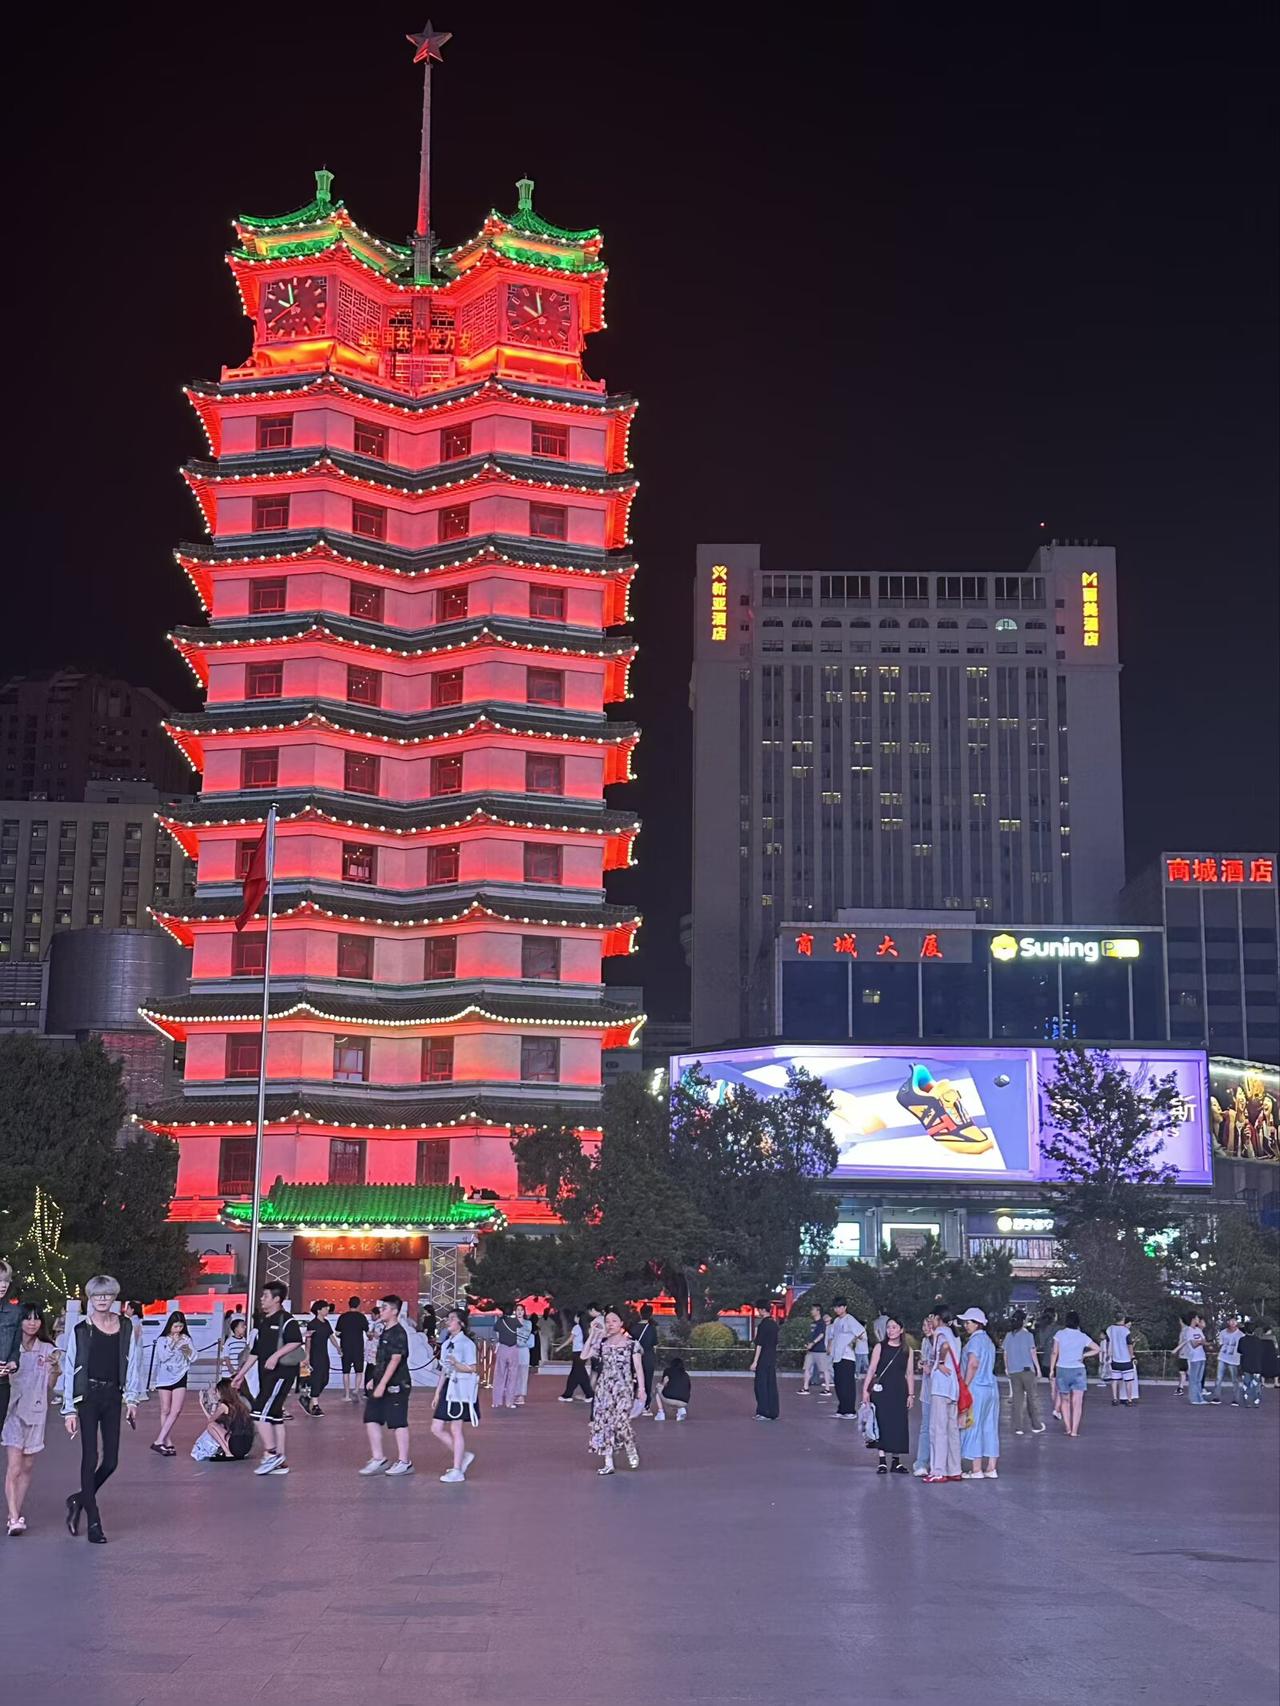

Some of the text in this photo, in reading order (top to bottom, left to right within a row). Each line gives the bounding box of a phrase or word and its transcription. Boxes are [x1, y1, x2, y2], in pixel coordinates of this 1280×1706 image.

[1166, 858, 1273, 882] 商城酒店
[795, 932, 943, 958] 商城大厦
[1019, 936, 1099, 962] Suning
